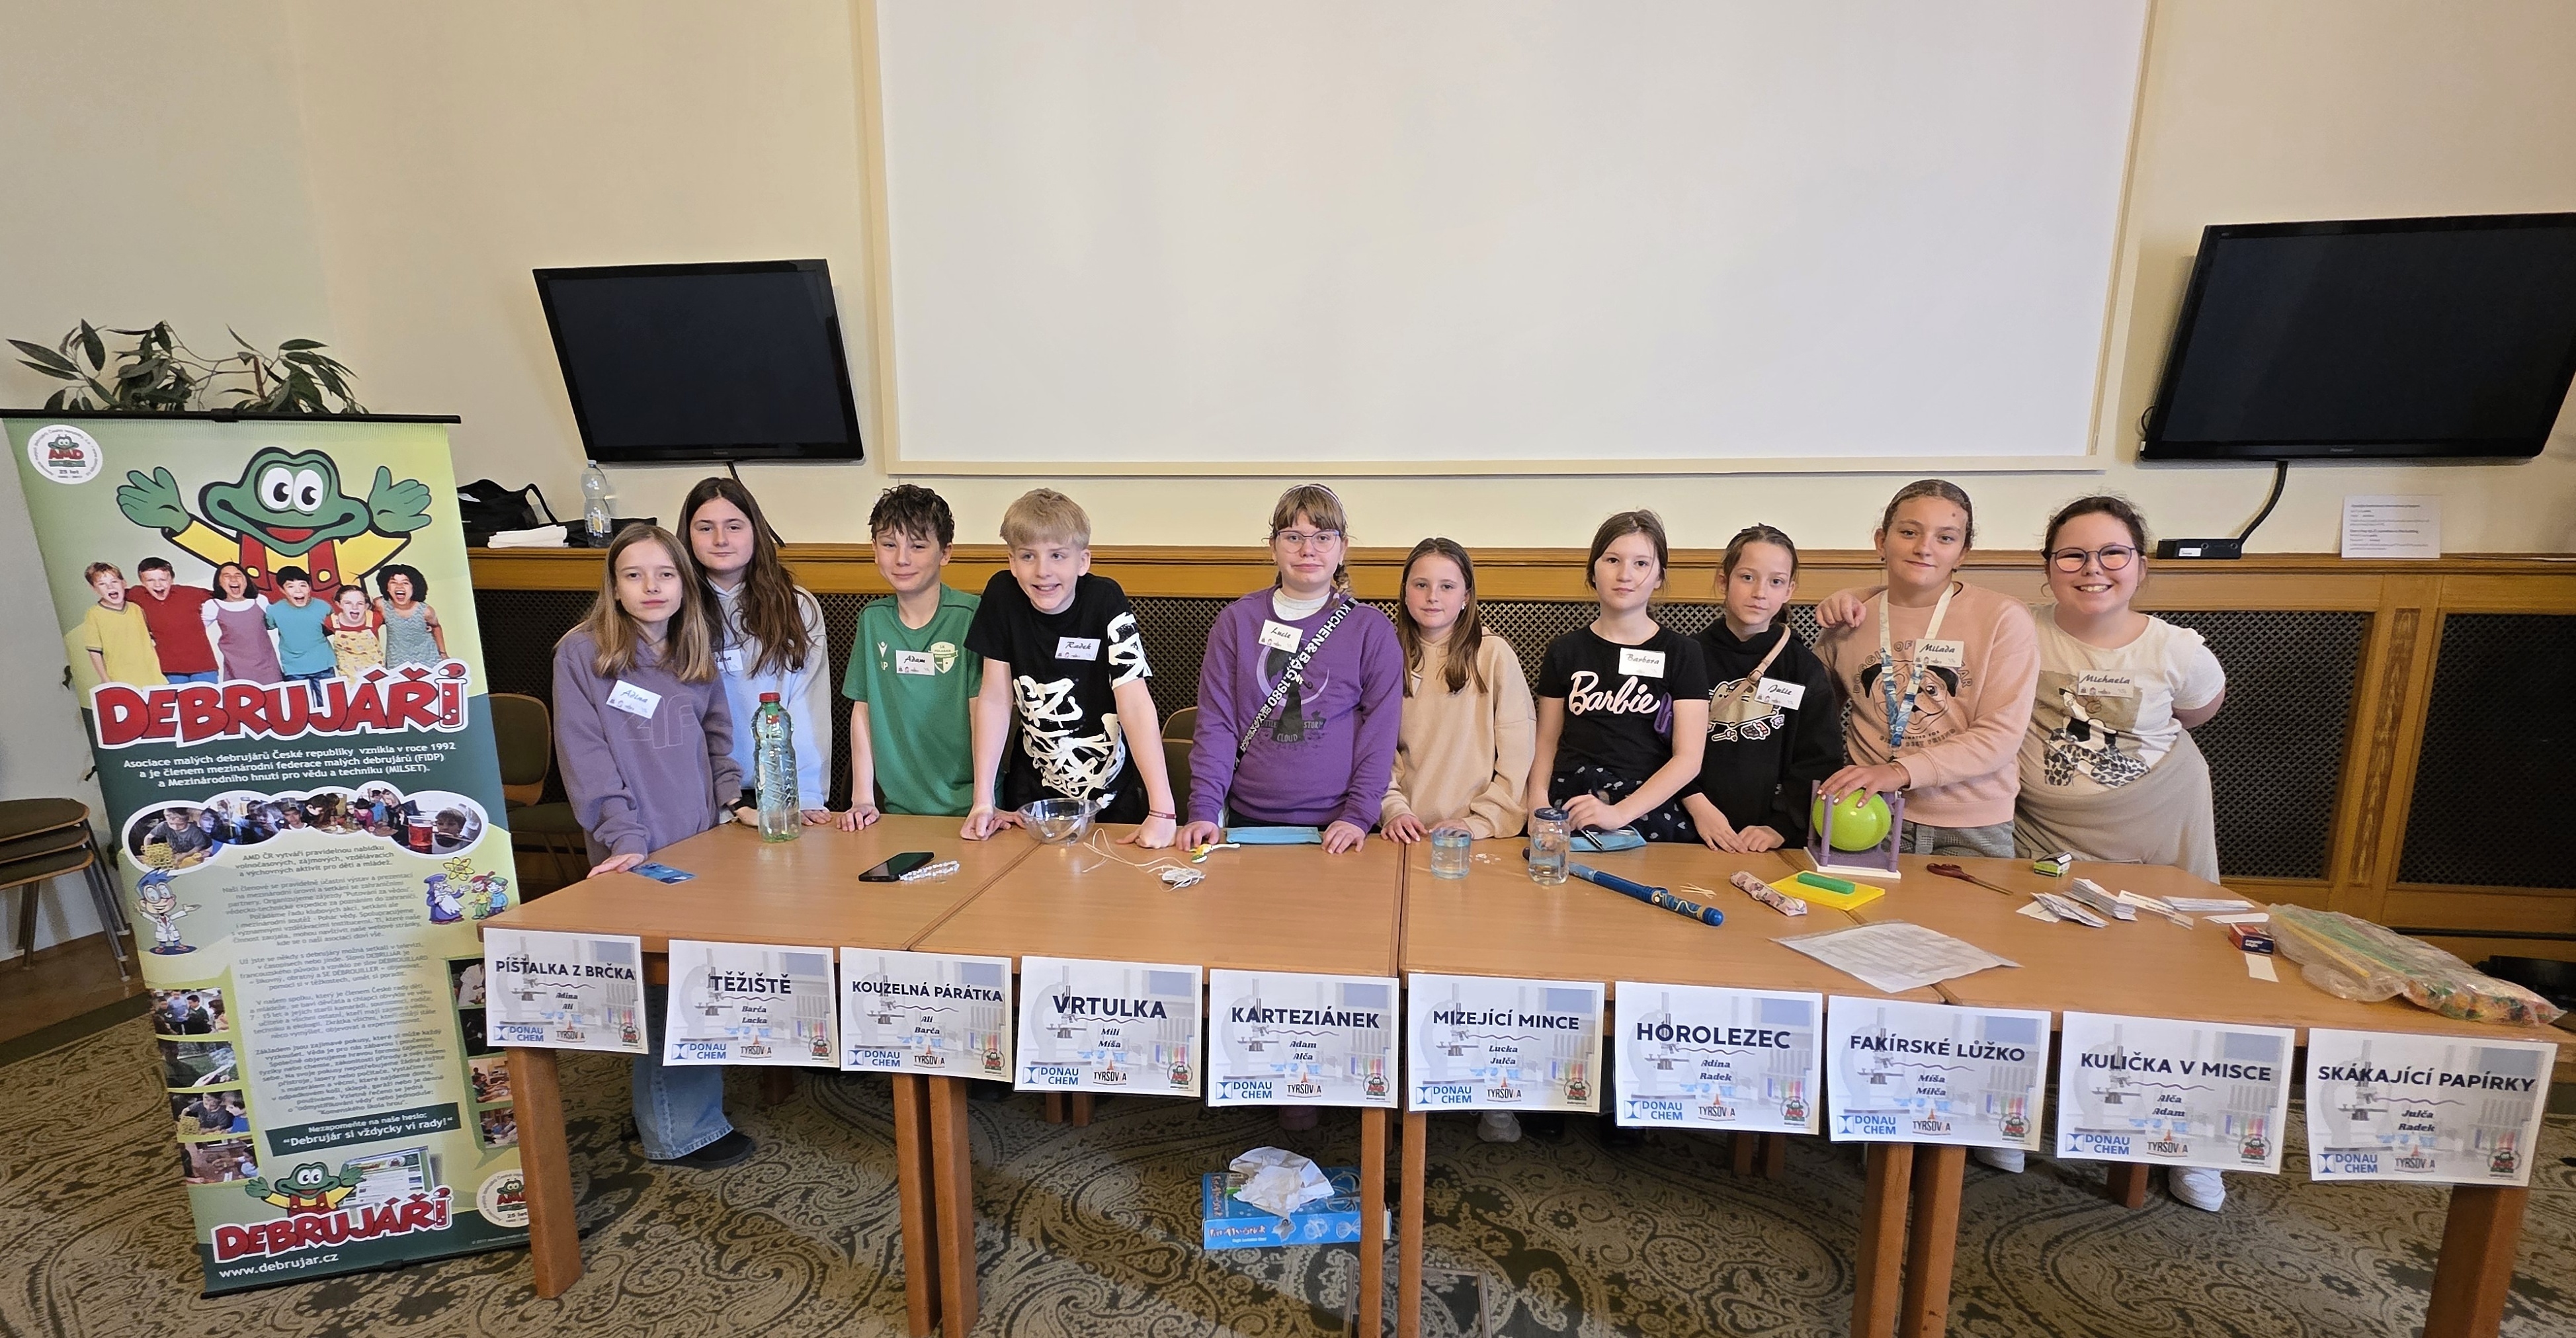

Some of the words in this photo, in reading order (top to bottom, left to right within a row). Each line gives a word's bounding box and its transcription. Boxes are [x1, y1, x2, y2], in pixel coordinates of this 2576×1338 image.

[1270, 626, 1292, 640] Lucie
[1893, 640, 1913, 651] OF
[1919, 644, 1956, 653] Milada
[904, 655, 925, 663] Adam
[1626, 653, 1660, 665] Barbora
[2082, 673, 2132, 685] Michaela
[1568, 671, 1661, 716] Barbie
[1768, 684, 1792, 696] Julie
[622, 689, 648, 703] Adina
[95, 662, 467, 745] DEBRUJÁŘI
[1276, 733, 1298, 742] CLOUD
[124, 759, 171, 768] Asociace
[173, 755, 213, 766] malých
[216, 751, 270, 763] debrujárů
[272, 749, 303, 759] České
[306, 747, 353, 759] republiky
[359, 745, 395, 755] vznikla
[431, 742, 456, 751] 1992
[149, 769, 160, 779] je
[163, 767, 204, 776] členem
[207, 761, 274, 774] mezinárodní
[276, 760, 321, 769] federace
[324, 757, 360, 767] malých
[362, 754, 412, 765] debrujárů
[414, 752, 444, 763] (FIDP)
[168, 774, 249, 787] Mezinárodního
[251, 771, 279, 781] hnutí
[282, 772, 300, 782] pro
[303, 769, 327, 778] vědu
[339, 766, 383, 776] techniku
[386, 764, 431, 774] (MILSET).
[306, 847, 352, 857] pravidelnou
[495, 956, 569, 976] PÍŠŤALKA
[573, 965, 581, 976] Z
[585, 963, 636, 980] BRČKA
[710, 971, 792, 994] TĚŽIŠTĚ
[852, 981, 930, 997] KOUZELNÁ
[934, 984, 1003, 1002] PÁRÁTKA
[1052, 995, 1167, 1019] VRTULKA
[1231, 1006, 1380, 1029] KARTEZIÁNEK
[1433, 1009, 1513, 1026] MIZEJÍCÍ
[1518, 1014, 1579, 1030] MINCE
[1637, 1023, 1791, 1049] HOROLEZEC
[1850, 1033, 1950, 1056] FAKÍRSKÉ
[1957, 1040, 2025, 1062] LŮŽKO
[864, 1050, 900, 1059] DONAU
[1700, 1060, 1731, 1068] Adina
[2081, 1051, 2172, 1073] KULIČKA
[2180, 1060, 2195, 1075] V
[2202, 1063, 2271, 1081] MISCE
[1041, 1067, 1079, 1076] DONAU
[1700, 1073, 1733, 1081] Radek
[1048, 1076, 1079, 1085] CHEM
[2317, 1063, 2434, 1086] SKÁKAJÍCÍ
[2439, 1071, 2536, 1092] PAPÍRKY
[1433, 1086, 1472, 1095] DONAU
[1441, 1095, 1472, 1103] CHEM
[2157, 1094, 2182, 1103] Alča
[1642, 1101, 1683, 1110] DONAU
[1651, 1111, 1683, 1120] CHEM
[2151, 1107, 2186, 1117] Adam
[2401, 1109, 2434, 1118] Julča
[308, 1120, 366, 1133] Nezapomeňte
[402, 1112, 428, 1121] heslo:
[1854, 1115, 1897, 1125] DONAU
[345, 1130, 354, 1139] si
[357, 1123, 402, 1138] vždycky
[1863, 1125, 1897, 1135] CHEM
[2398, 1123, 2435, 1132] Radek
[2085, 1135, 2130, 1146] DONAU
[2093, 1145, 2130, 1155] CHEM
[2335, 1153, 2378, 1164] DONAU
[2345, 1163, 2378, 1173] CHEM
[215, 1188, 452, 1261] DEBRUJÁŘI
[218, 1253, 339, 1278] www.debrujar.cz
